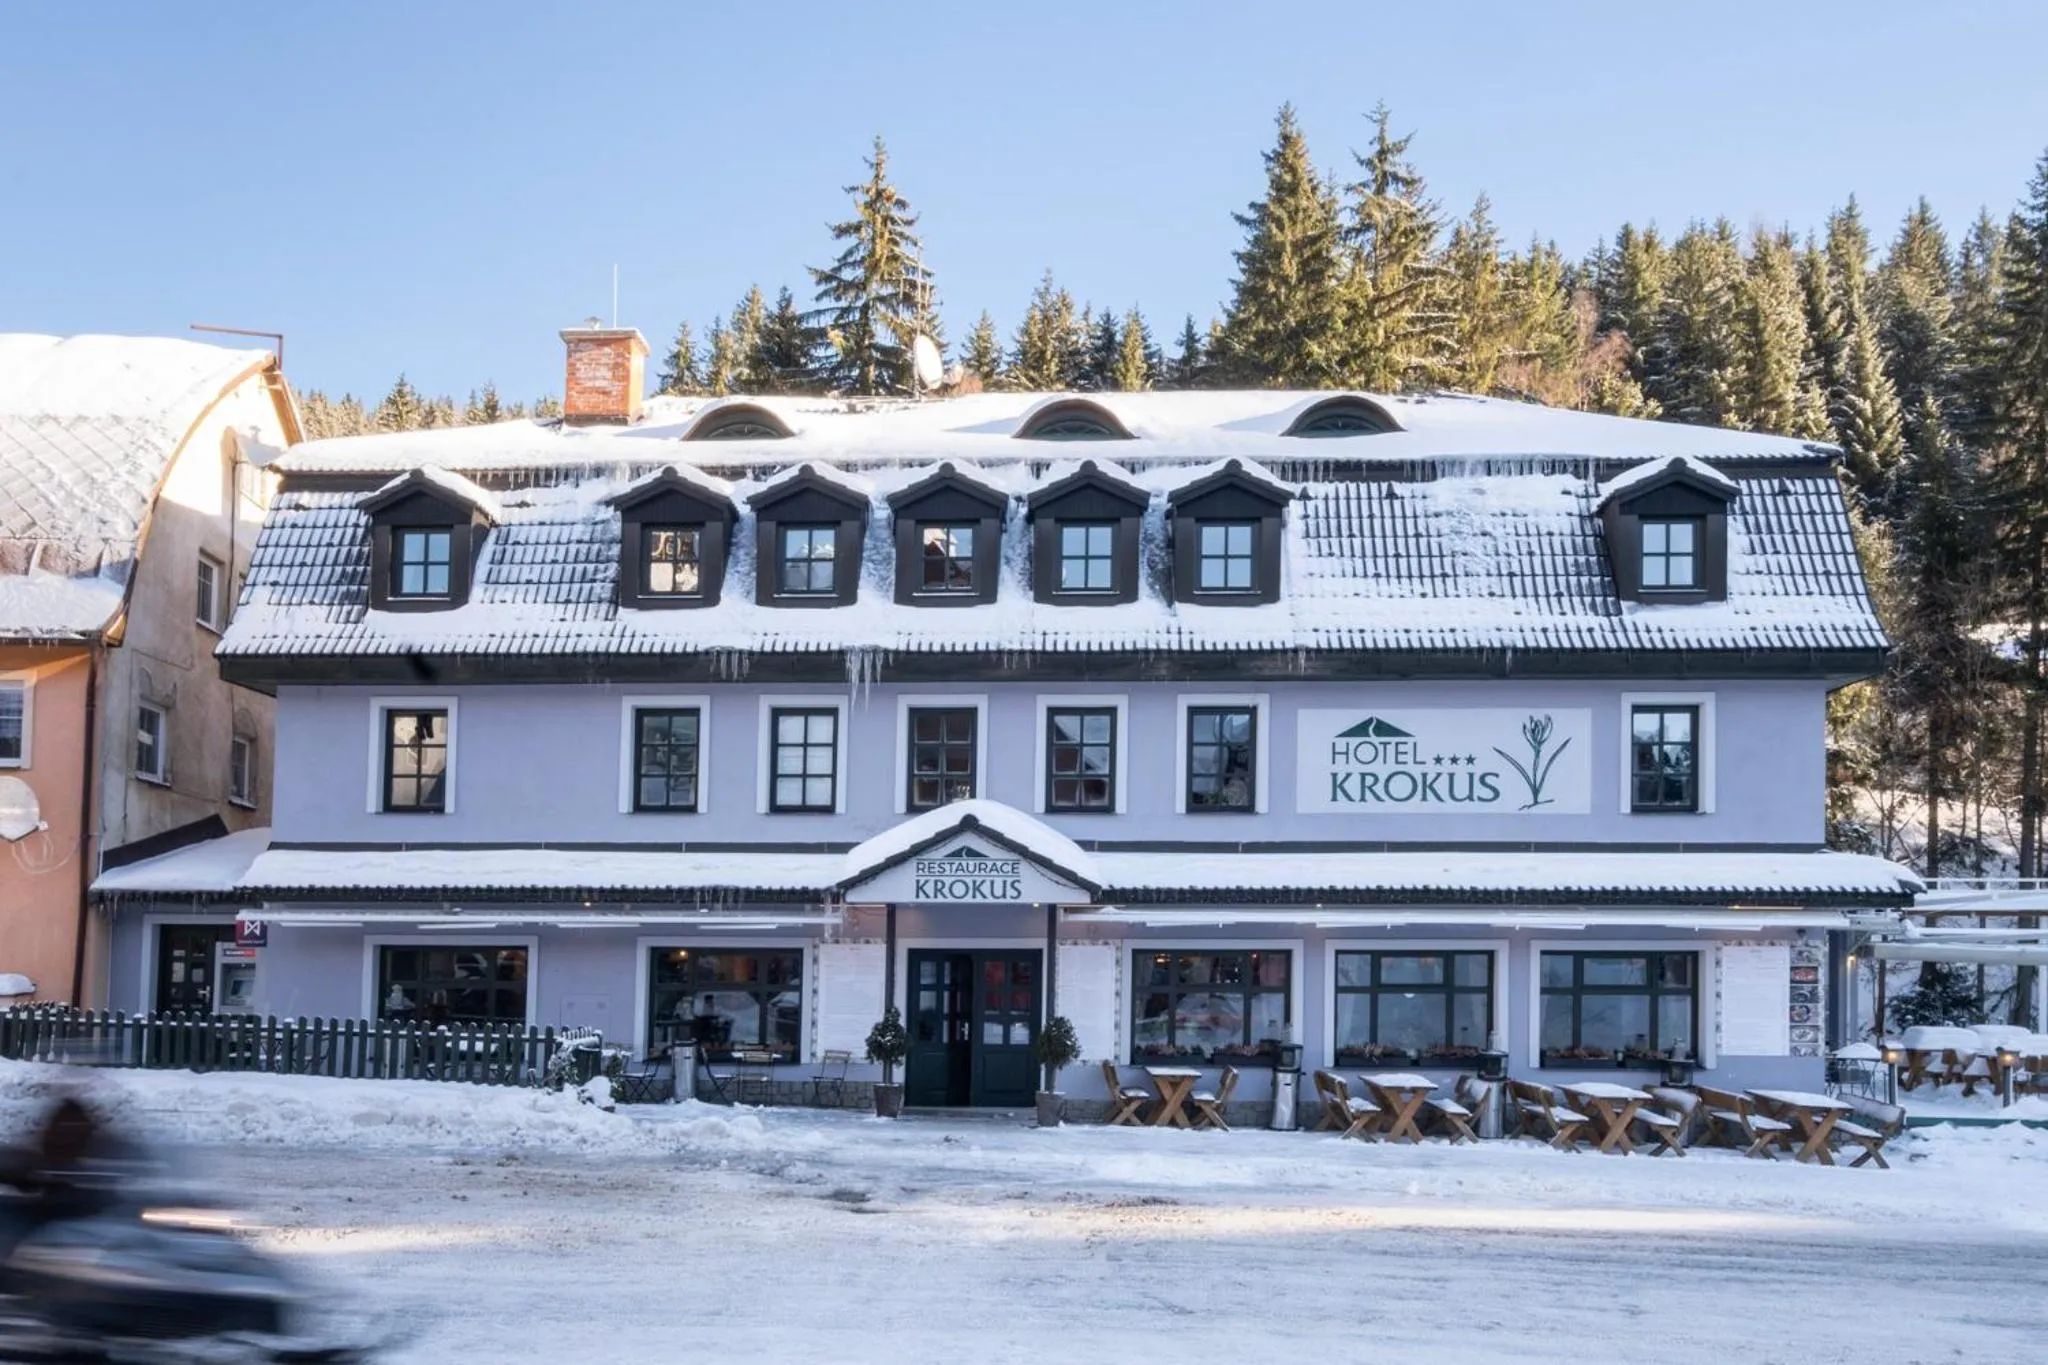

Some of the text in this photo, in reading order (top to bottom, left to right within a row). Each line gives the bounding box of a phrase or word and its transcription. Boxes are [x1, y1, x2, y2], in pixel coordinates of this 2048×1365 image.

[1332, 741, 1426, 765] HOTEL
[1330, 771, 1500, 803] KROKUS
[916, 862, 1021, 874] RESTAURACE
[915, 879, 1022, 899] KROKUS
